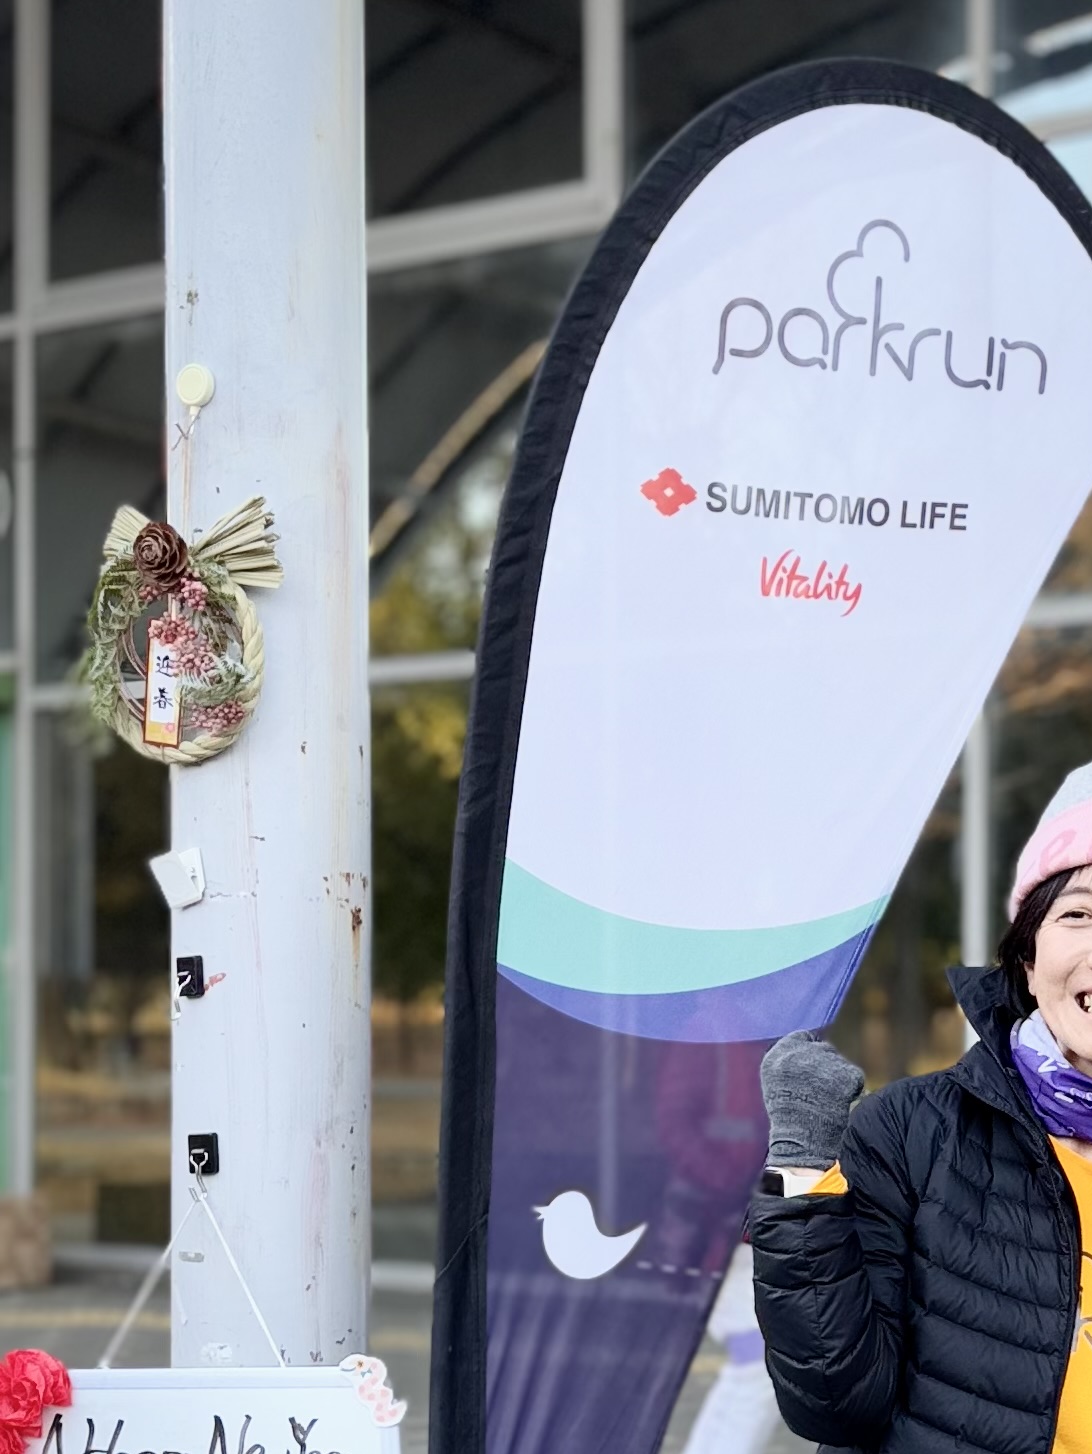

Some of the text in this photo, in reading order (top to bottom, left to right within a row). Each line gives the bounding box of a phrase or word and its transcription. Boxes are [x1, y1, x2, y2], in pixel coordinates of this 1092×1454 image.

[711, 218, 1048, 395] parkrun
[705, 481, 970, 531] SUMITOMO LIFE
[760, 548, 863, 618] Vitality
